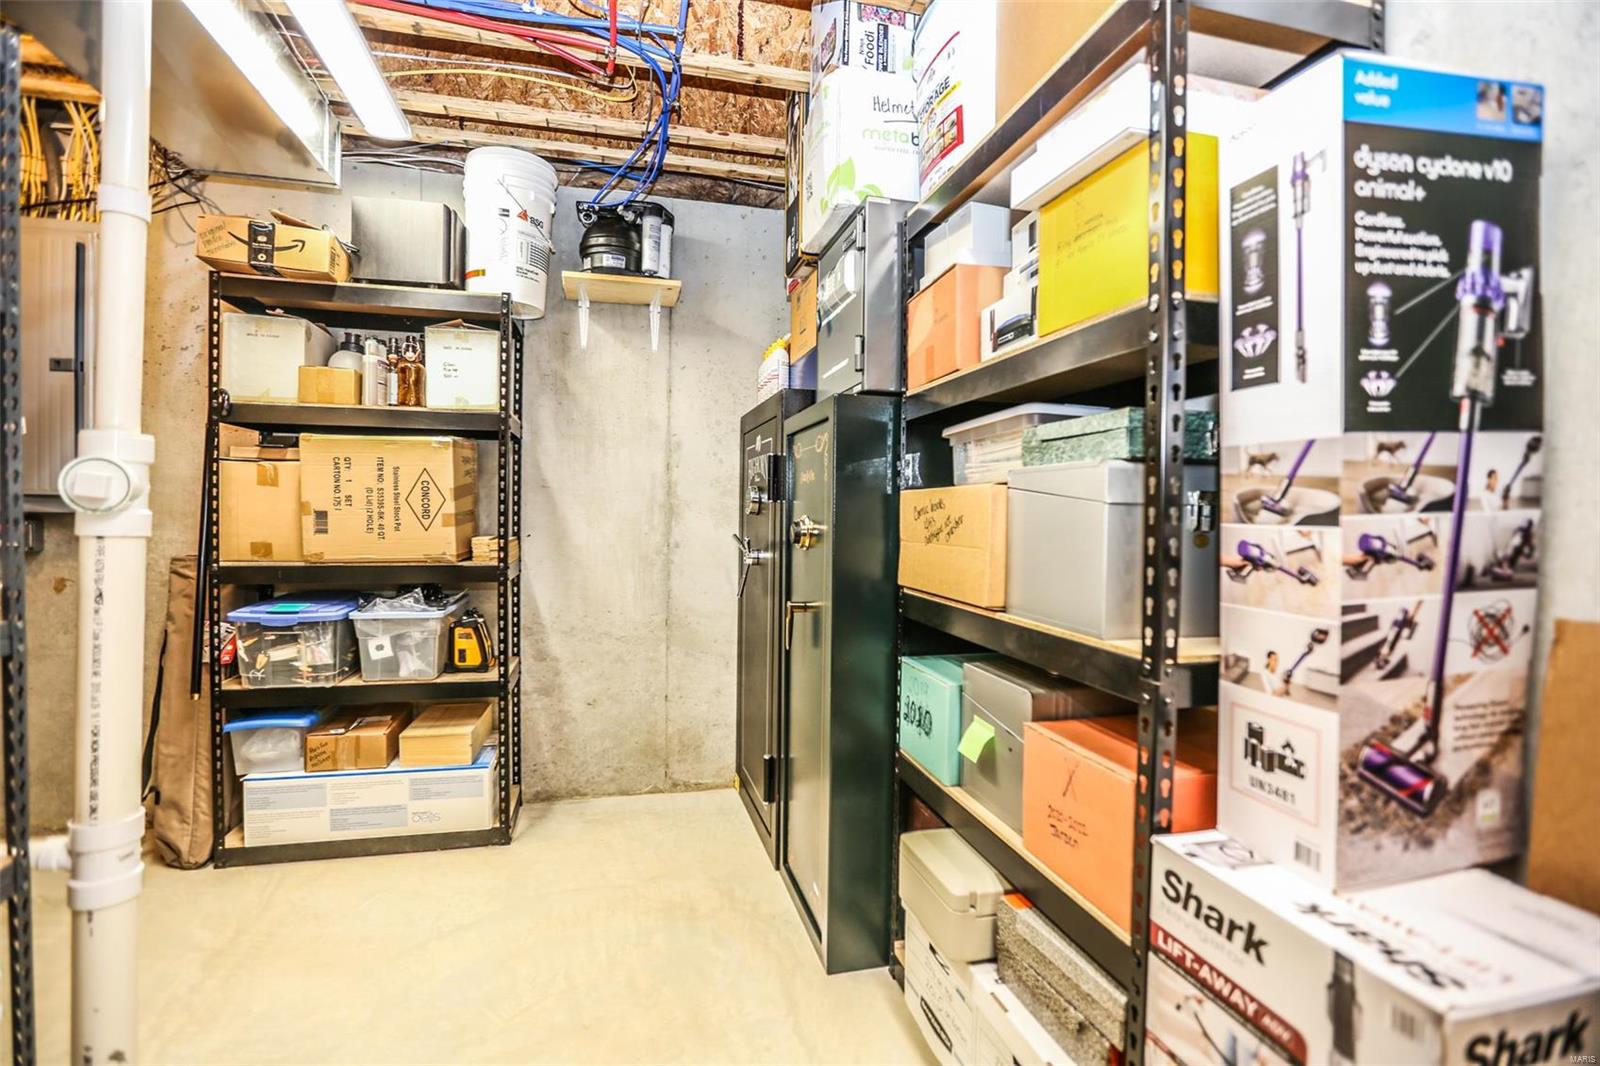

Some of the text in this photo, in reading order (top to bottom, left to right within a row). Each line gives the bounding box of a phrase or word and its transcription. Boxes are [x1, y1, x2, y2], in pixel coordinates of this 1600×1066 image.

[864, 30, 875, 65] Foodi
[877, 25, 885, 71] OWER BLENDER
[1354, 69, 1399, 90] Added
[1354, 91, 1391, 109] value
[1353, 144, 1513, 183] dyson cyclone v10
[1354, 178, 1426, 202] animal+
[332, 457, 341, 483] CARTON
[376, 457, 384, 472] ITEM
[392, 466, 400, 491] Stainless
[420, 480, 430, 520] CONCORD
[366, 515, 374, 534] HOLE)
[393, 506, 401, 521] Stock
[1161, 869, 1268, 967] Shark
[1157, 929, 1258, 1018] LIFT-AWAY
[1465, 1009, 1590, 1066] Shark
